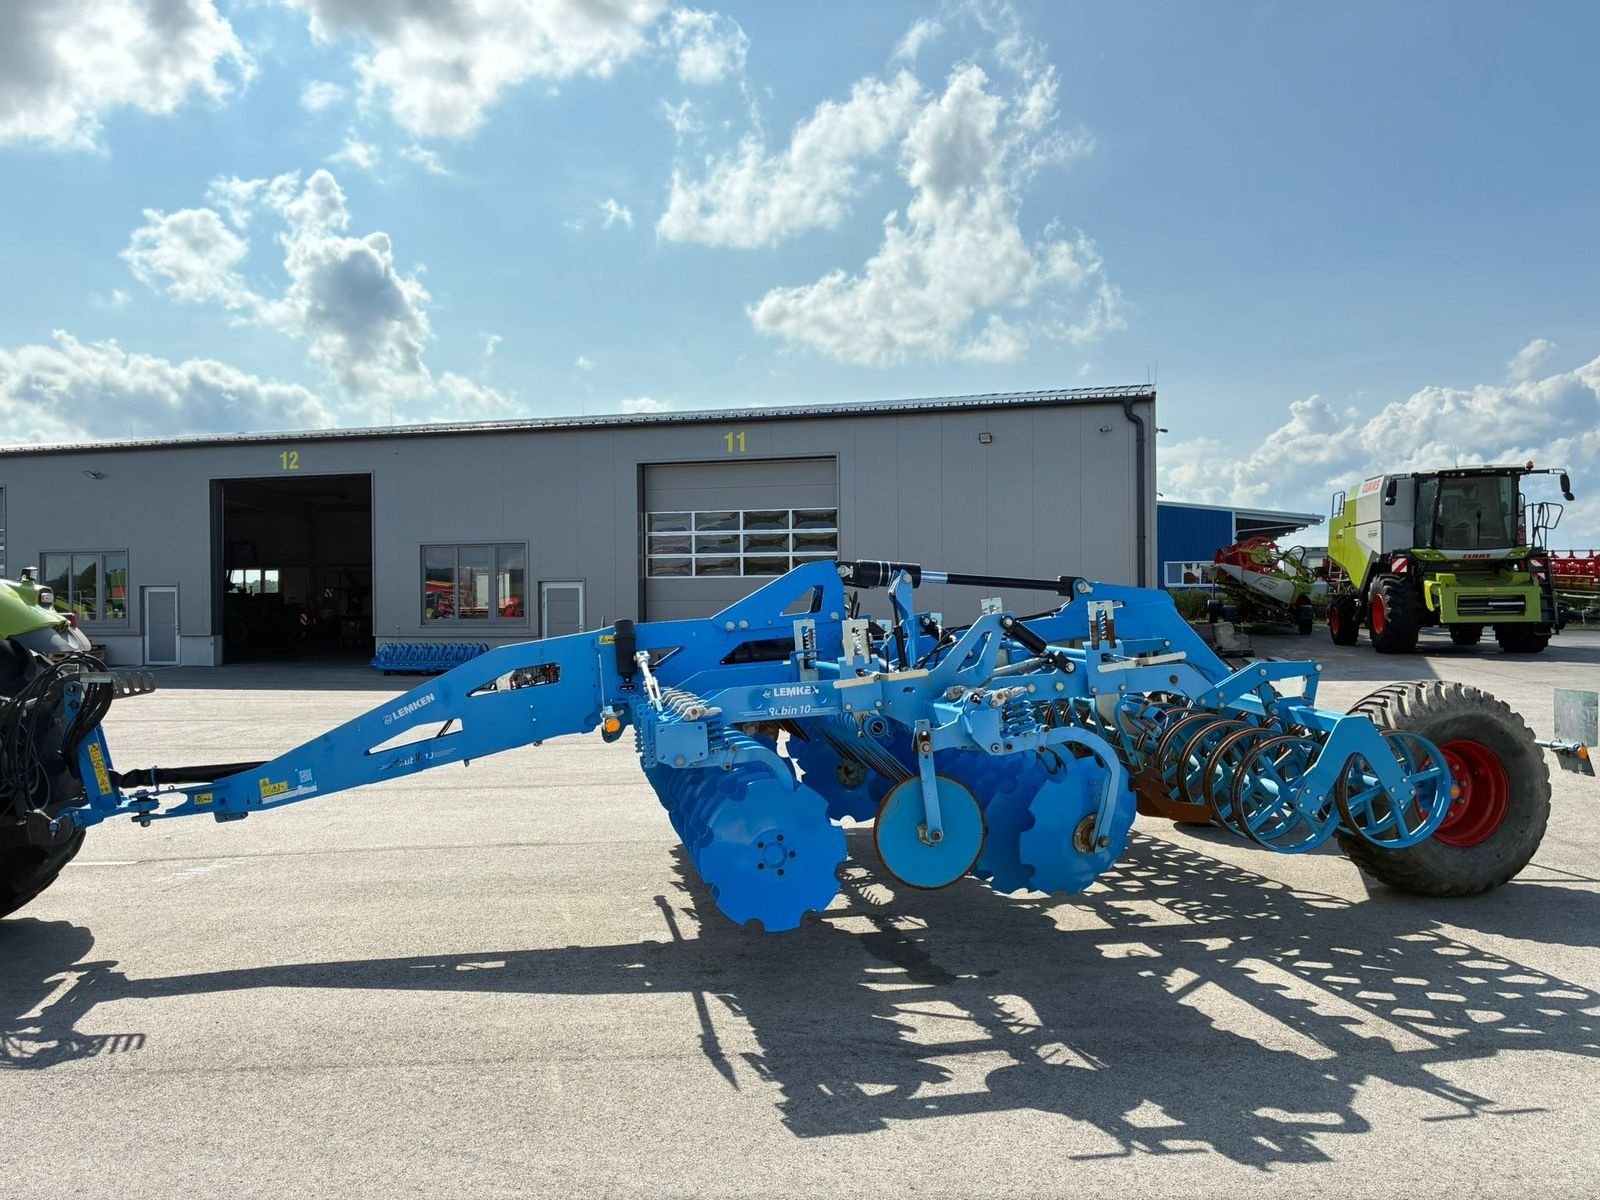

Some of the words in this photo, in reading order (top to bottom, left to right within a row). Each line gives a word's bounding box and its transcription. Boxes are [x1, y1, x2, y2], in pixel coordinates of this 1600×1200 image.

[724, 431, 745, 453] 11
[279, 450, 299, 470] 12
[392, 692, 436, 720] LEMKEN
[768, 704, 798, 717] Rubin
[799, 704, 811, 714] 10
